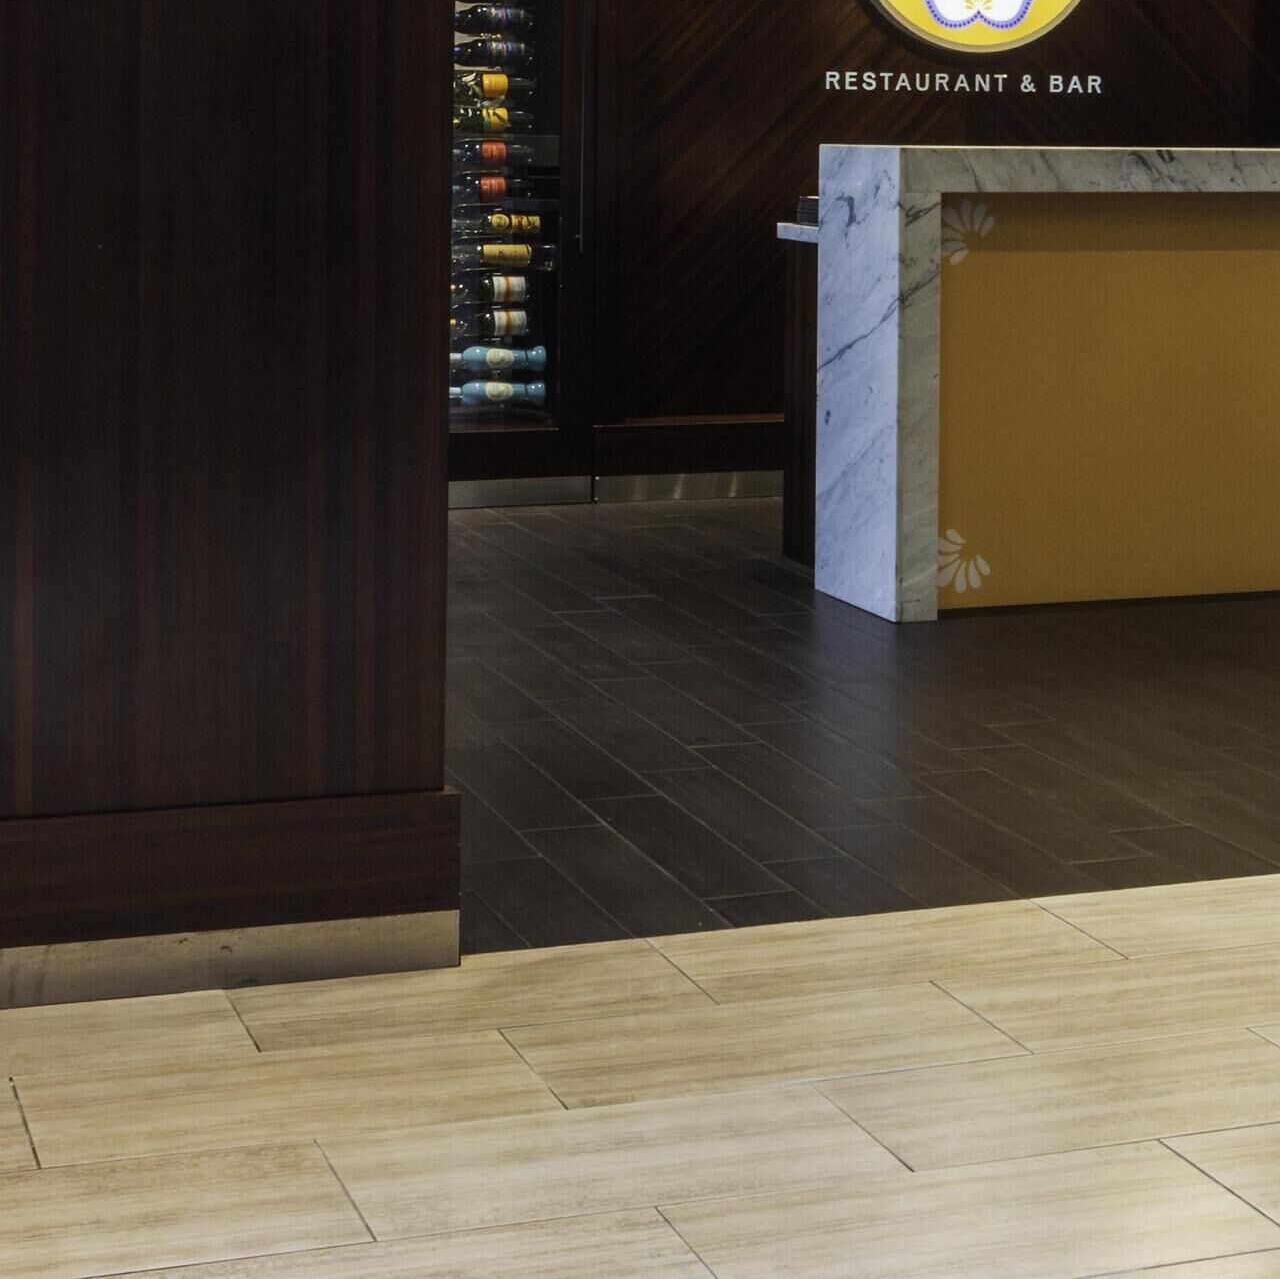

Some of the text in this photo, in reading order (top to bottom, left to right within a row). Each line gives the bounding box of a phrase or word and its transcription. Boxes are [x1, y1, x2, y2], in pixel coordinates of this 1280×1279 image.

[825, 72, 1102, 94] RESTAURANT & BAR
